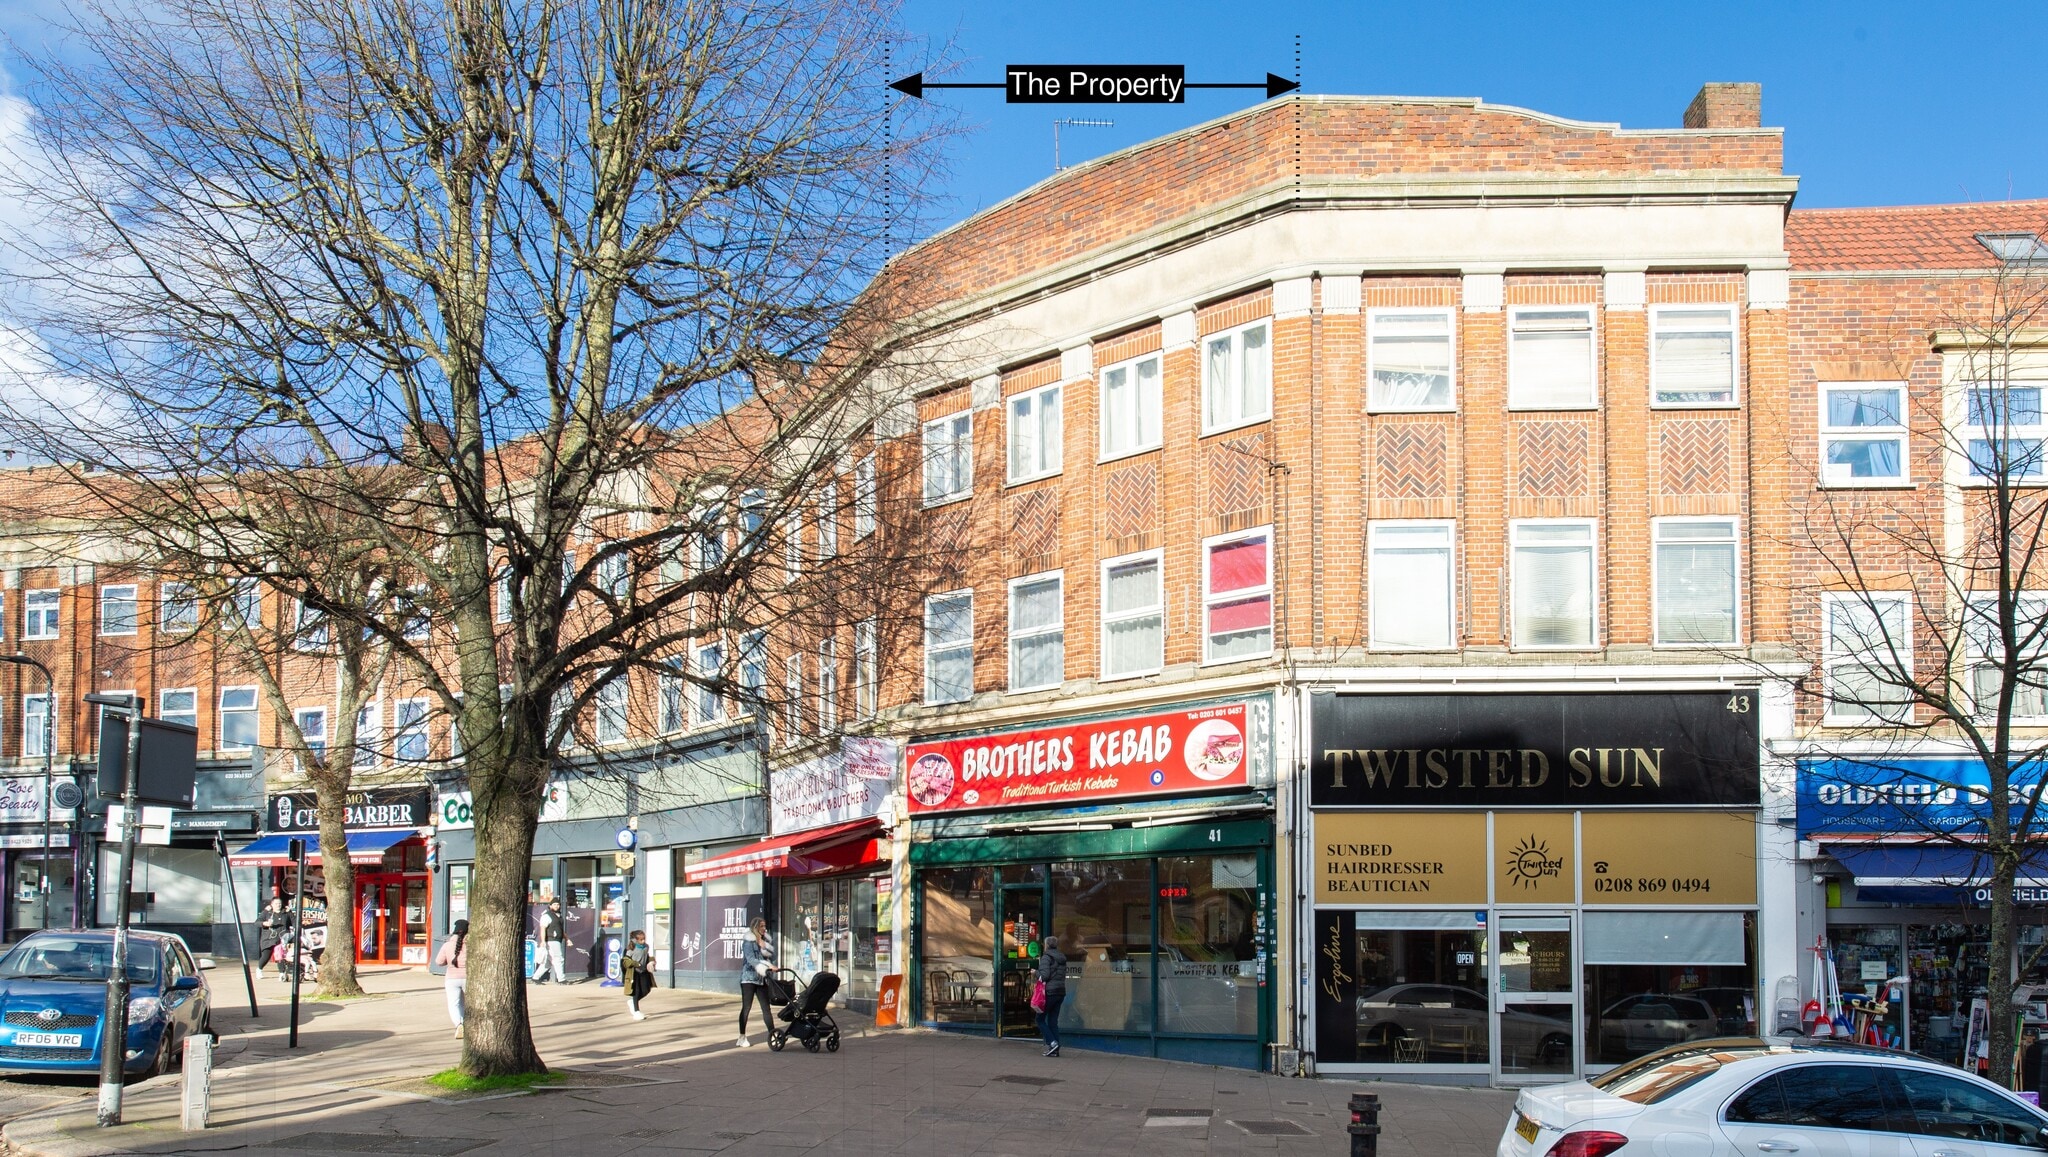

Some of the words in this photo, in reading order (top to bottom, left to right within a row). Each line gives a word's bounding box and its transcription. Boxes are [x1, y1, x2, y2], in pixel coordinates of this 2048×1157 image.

[1726, 695, 1750, 713] 43
[1187, 712, 1199, 721] Tel:
[907, 748, 916, 756] 41
[962, 735, 1074, 783] BROTHERS
[1089, 723, 1173, 770] KEBAB
[1323, 748, 1550, 789] TWISTED
[1569, 747, 1665, 788] SUN
[6, 780, 33, 795] Rose
[1002, 783, 1048, 798] Traditional
[1048, 777, 1082, 793] Turkish
[1083, 774, 1119, 790] Kebabs
[1817, 783, 1957, 805] OLDFIELD
[0, 796, 40, 812] Beauty
[783, 800, 826, 820] TRADITIONAL
[833, 788, 869, 809] BUTCHERS
[345, 804, 413, 825] BARBER
[1822, 816, 1886, 826] HOUSEWARE
[1928, 816, 1981, 826] GARDENIN
[1208, 828, 1222, 842] 41
[1326, 844, 1392, 857] SUNBED
[1327, 862, 1444, 875] HAIRDRESSER
[1160, 887, 1188, 897] OPEN
[1327, 880, 1431, 892] BEAUTICIAN
[1594, 877, 1634, 893] 0208
[1637, 877, 1667, 893] 869
[1671, 877, 1711, 893] 0494
[1322, 914, 1353, 1003] Ergoline
[1457, 952, 1475, 965] OPEN
[1539, 951, 1566, 959] HOURS
[18, 1033, 52, 1044] RF06
[55, 1035, 80, 1045] VRC
